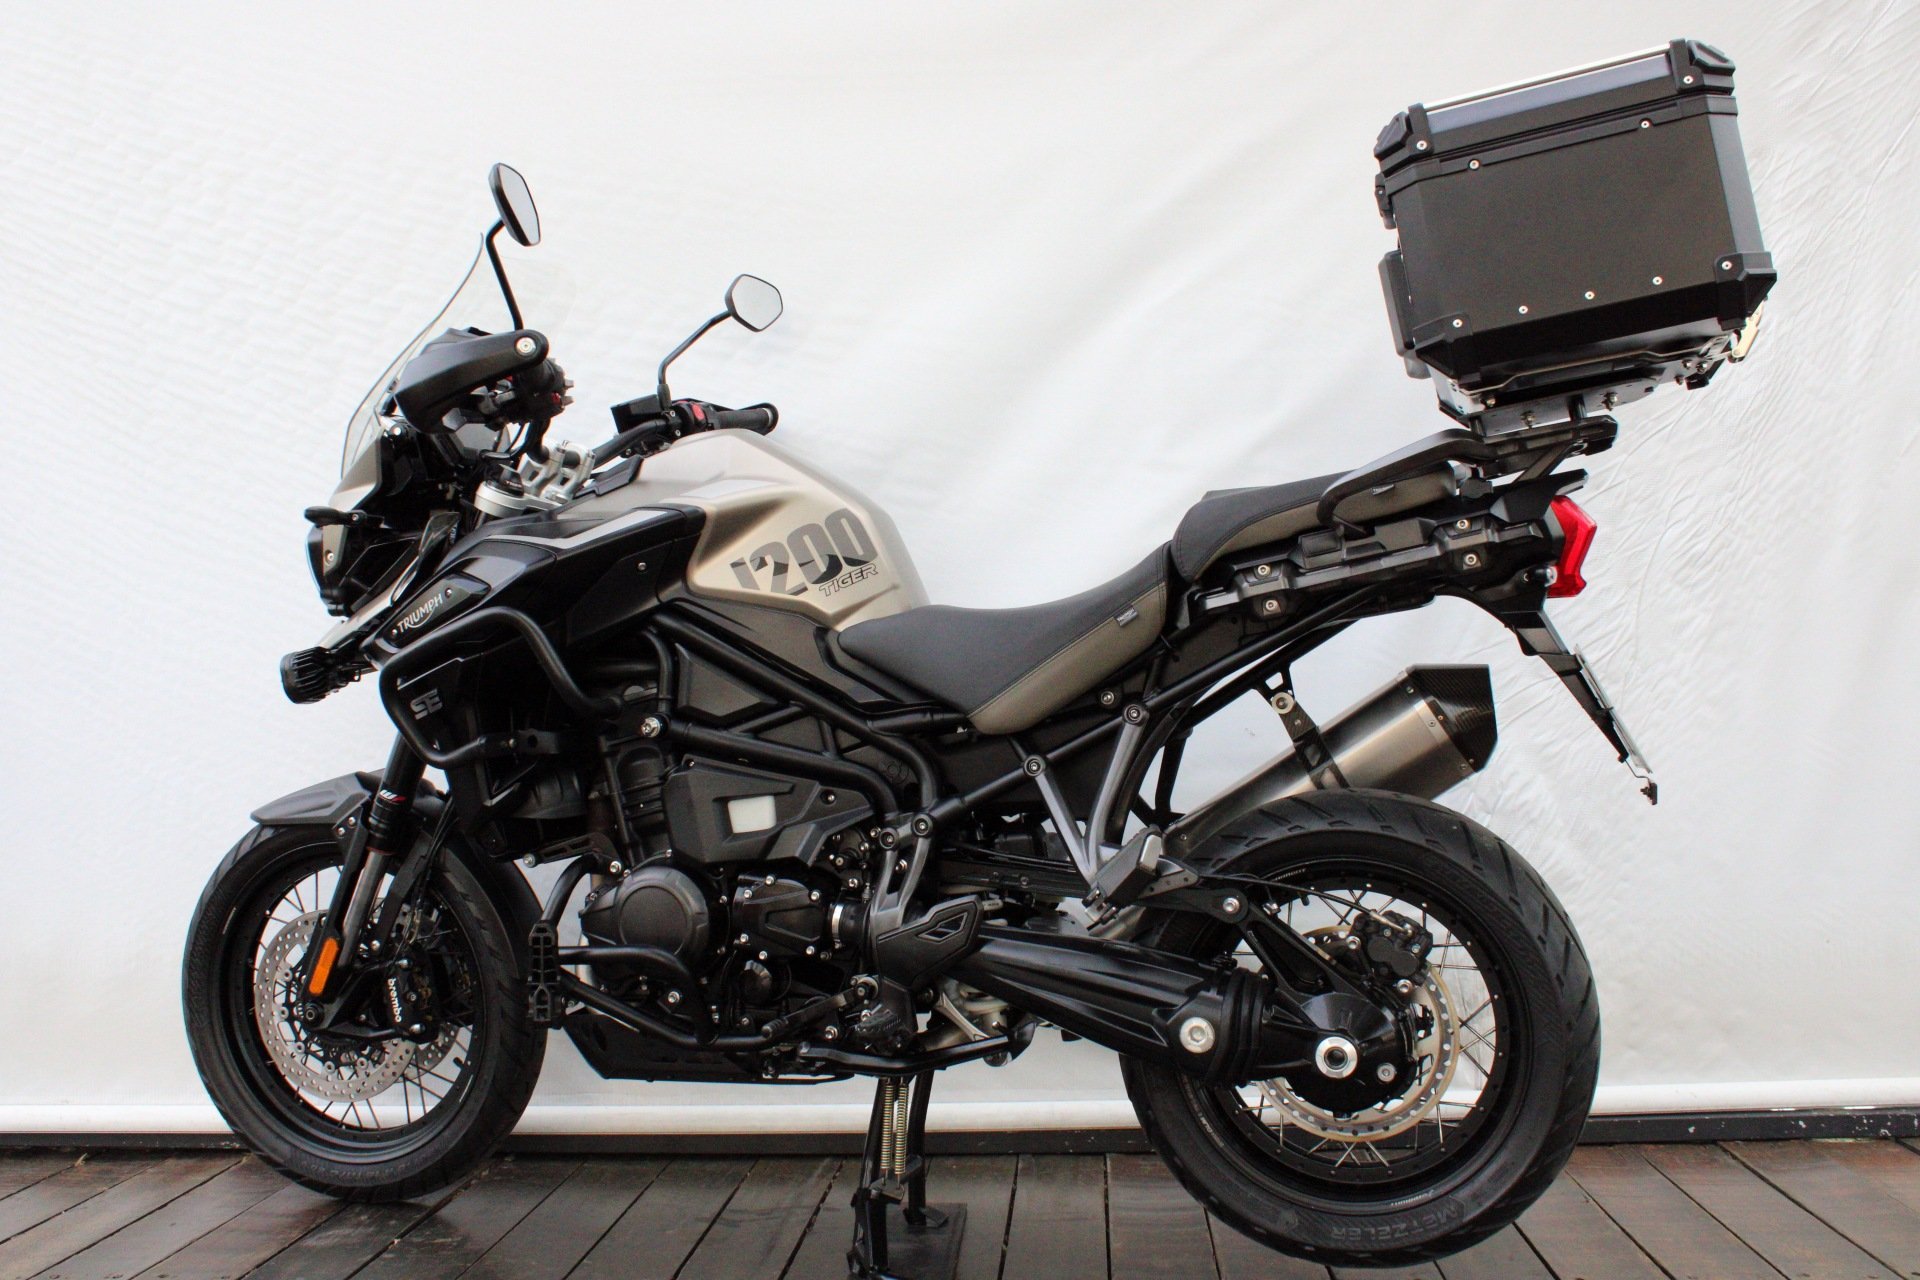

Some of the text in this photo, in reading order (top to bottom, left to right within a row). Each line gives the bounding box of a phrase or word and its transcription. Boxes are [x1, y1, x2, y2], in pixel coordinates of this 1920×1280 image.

[730, 508, 878, 596] 1200
[819, 563, 878, 597] TIGER
[397, 594, 443, 633] TRIUMPH
[388, 978, 402, 1022] brembo
